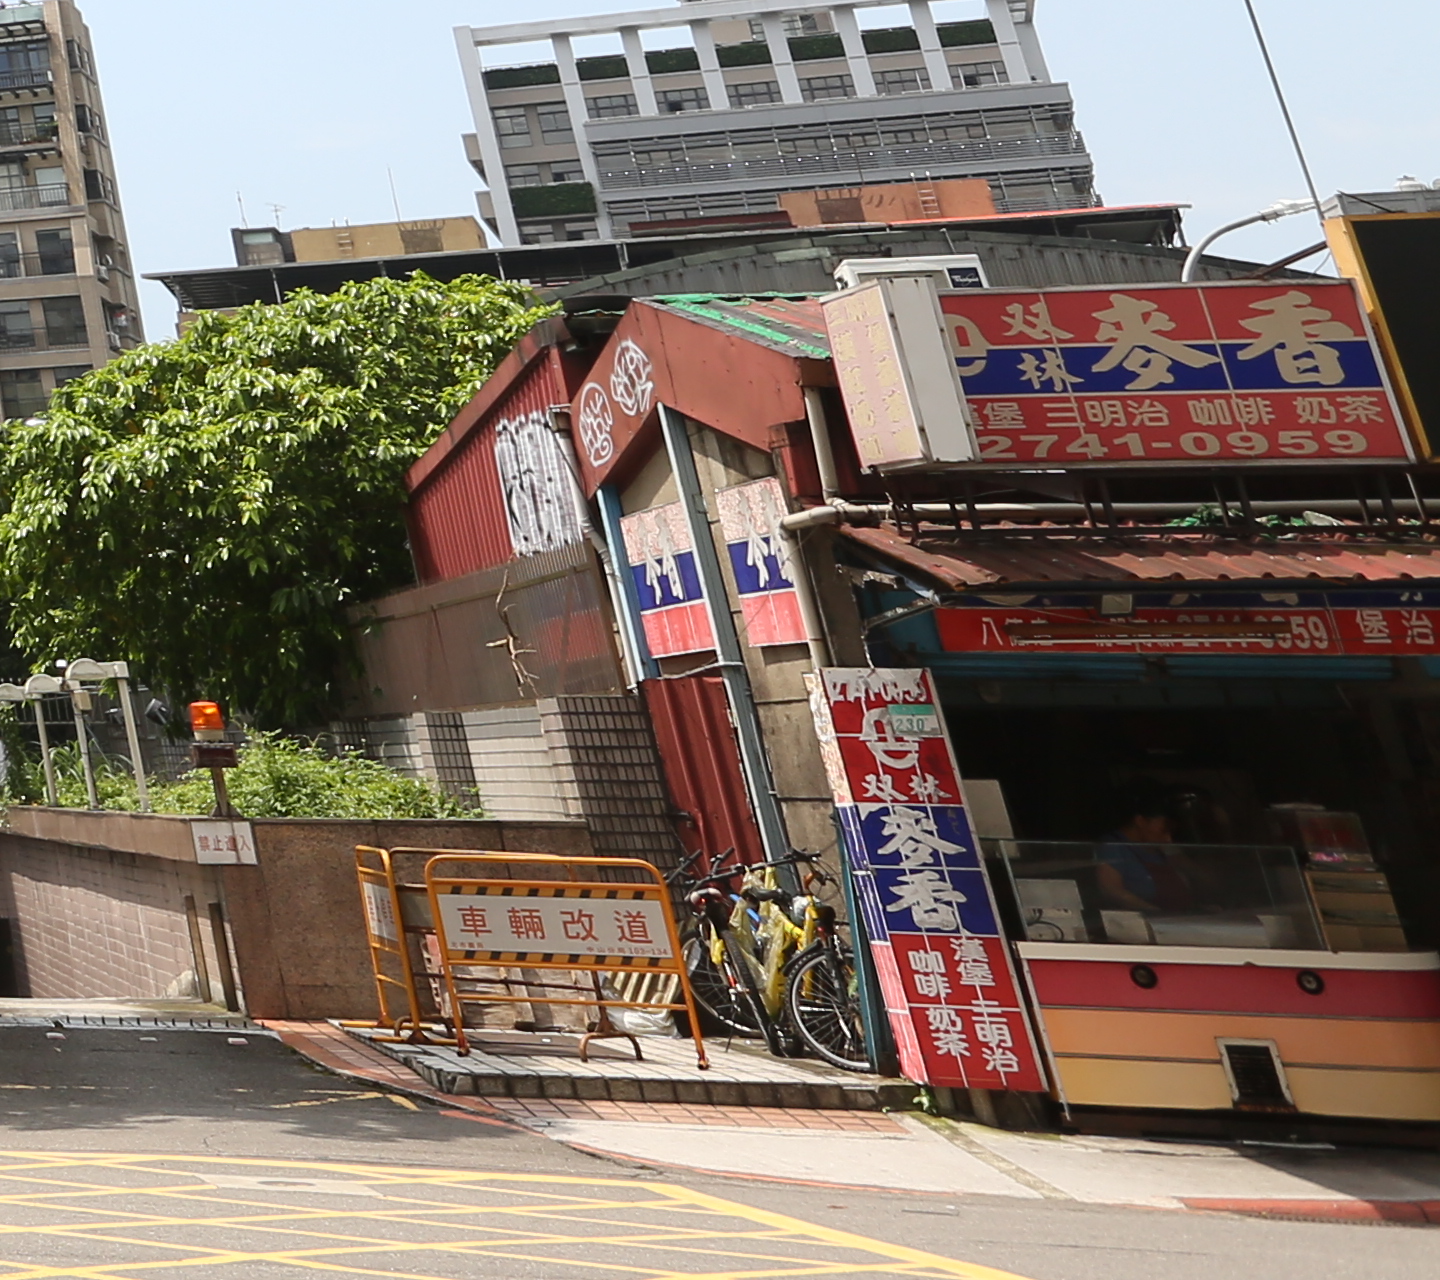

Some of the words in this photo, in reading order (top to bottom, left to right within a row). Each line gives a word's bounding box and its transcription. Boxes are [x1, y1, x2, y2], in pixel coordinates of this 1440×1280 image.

[1043, 399, 1170, 429] 三明治
[1187, 397, 1276, 427] 咖啡
[1293, 395, 1385, 425] 奶茶
[978, 430, 1368, 460] 2741-0959
[895, 718, 926, 731] 230
[861, 773, 953, 803] 双林
[198, 835, 252, 853] 禁止進入
[457, 905, 654, 944] 車輛改道
[908, 949, 952, 998] 咖啡
[950, 937, 996, 987] 漢堡
[925, 1008, 971, 1057] 奶茶
[971, 1000, 1019, 1073] 三明治
